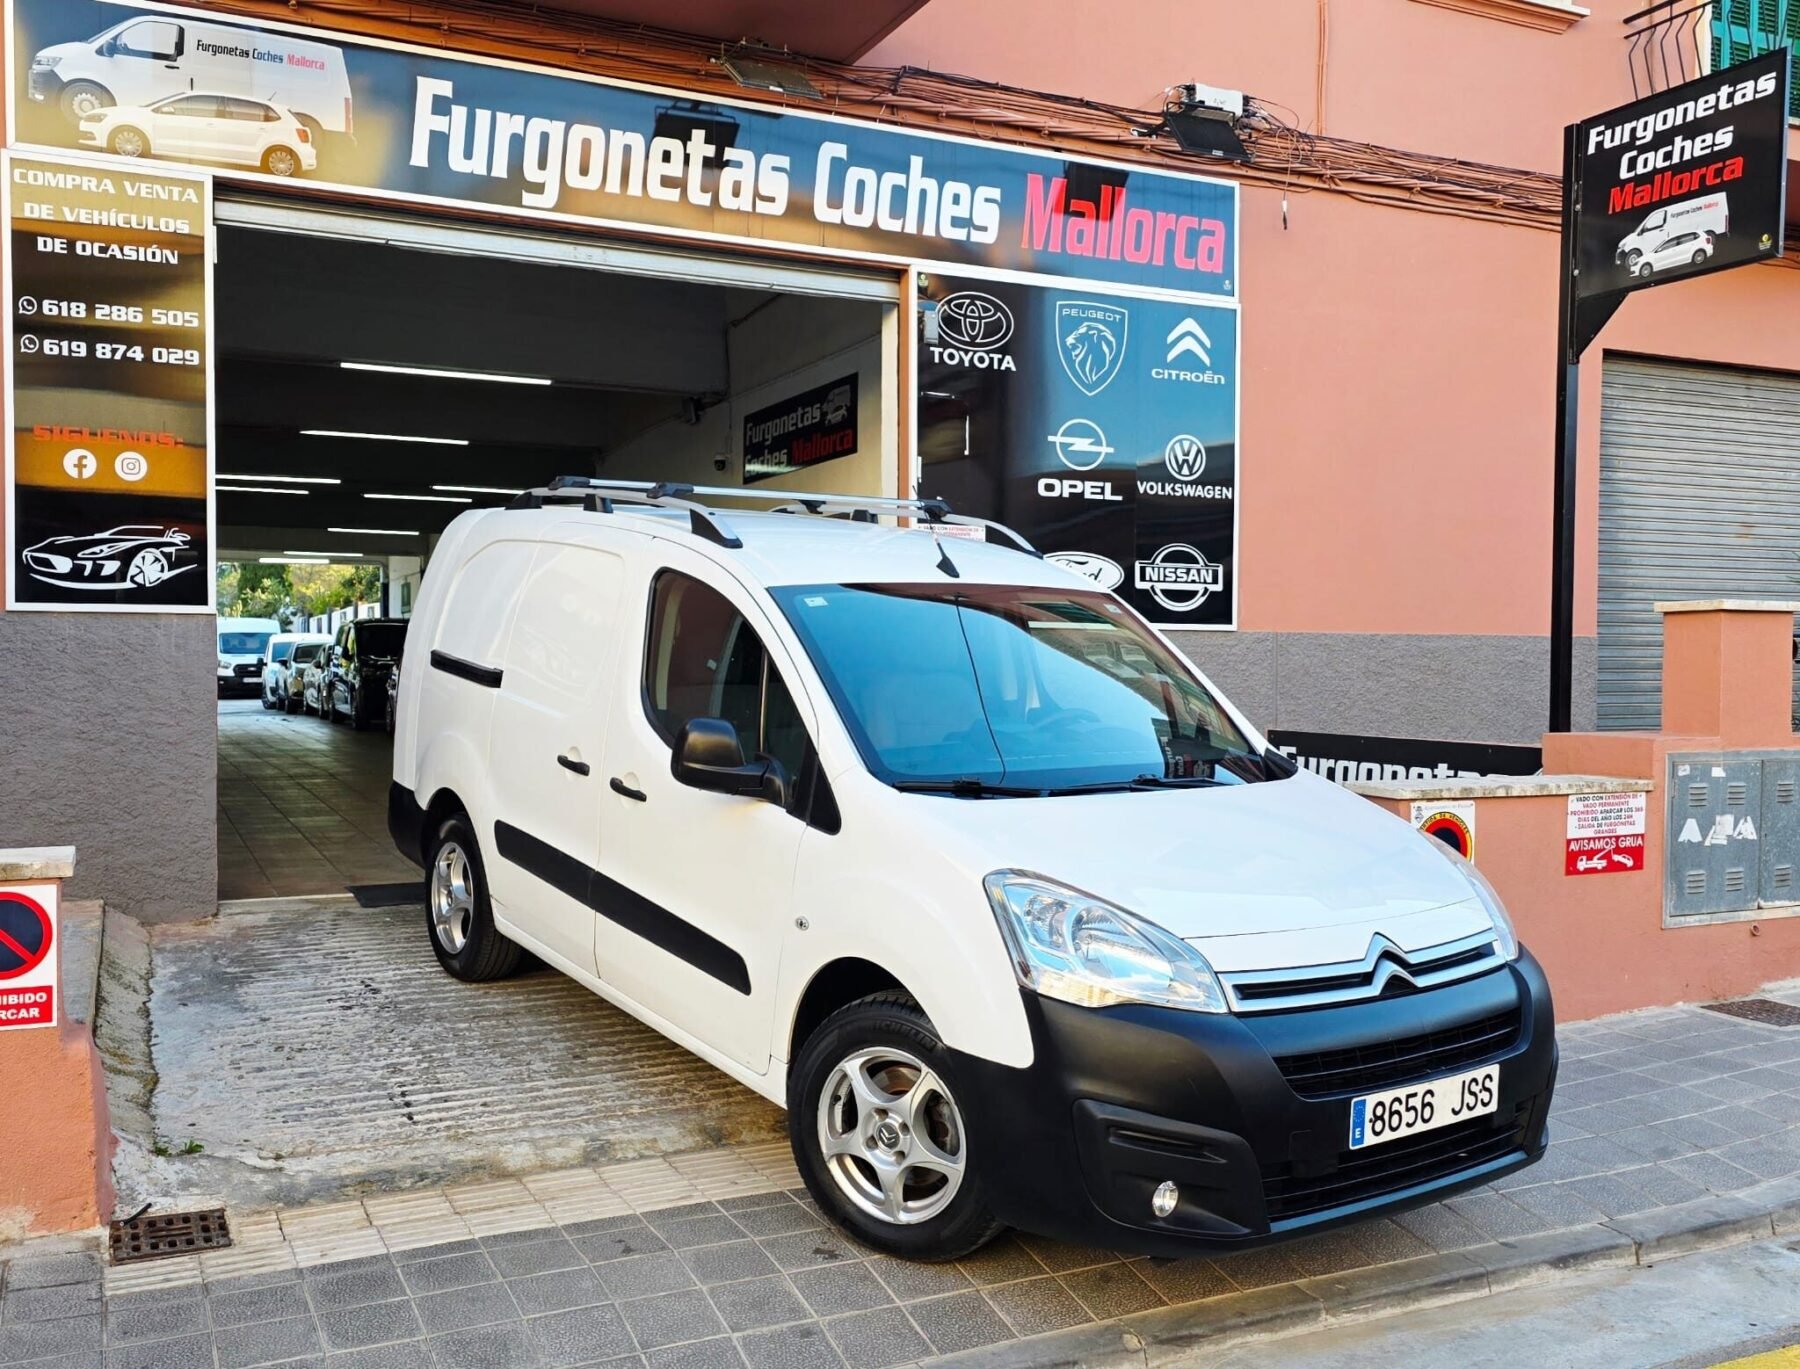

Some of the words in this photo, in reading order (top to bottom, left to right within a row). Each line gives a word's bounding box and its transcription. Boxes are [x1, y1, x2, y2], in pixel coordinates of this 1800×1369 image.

[196, 39, 250, 58] Furgonetas
[252, 47, 284, 63] Coches
[287, 53, 325, 70] Mallorca
[1587, 71, 1777, 156] Furgonetas
[1619, 125, 1734, 180] Coches
[13, 168, 116, 194] COMPRA
[123, 180, 199, 203] VENTA
[409, 76, 790, 217] Furgonetas
[813, 140, 1001, 245] Coches
[1020, 173, 1226, 274] Mallorca
[1608, 156, 1744, 215] Mallorca
[24, 202, 54, 220] DE
[62, 206, 190, 234] VEHÍCULOS
[37, 236, 67, 254] DE
[76, 240, 178, 265] OCASIÓN
[42, 299, 86, 318] 618
[95, 304, 143, 323] 286
[152, 309, 199, 327] 505
[1061, 308, 1123, 323] PEUGEOT
[43, 338, 86, 358] 619
[96, 343, 144, 361] 874
[152, 347, 199, 366] 029
[929, 346, 1017, 371] TOYOTA
[745, 403, 821, 446] Furgonetas
[791, 429, 853, 466] Mallorca
[1037, 478, 1123, 501] OPEL
[1137, 480, 1233, 500] VOLKSWAGEN
[1144, 567, 1213, 584] NISSAN
[1569, 837, 1616, 852] AVISAMOS
[1618, 836, 1643, 848] GRUA
[0, 992, 47, 1006] IBIDO
[1371, 1089, 1435, 1137] 8656
[1451, 1073, 1493, 1116] JSS
[1354, 1128, 1361, 1138] E
